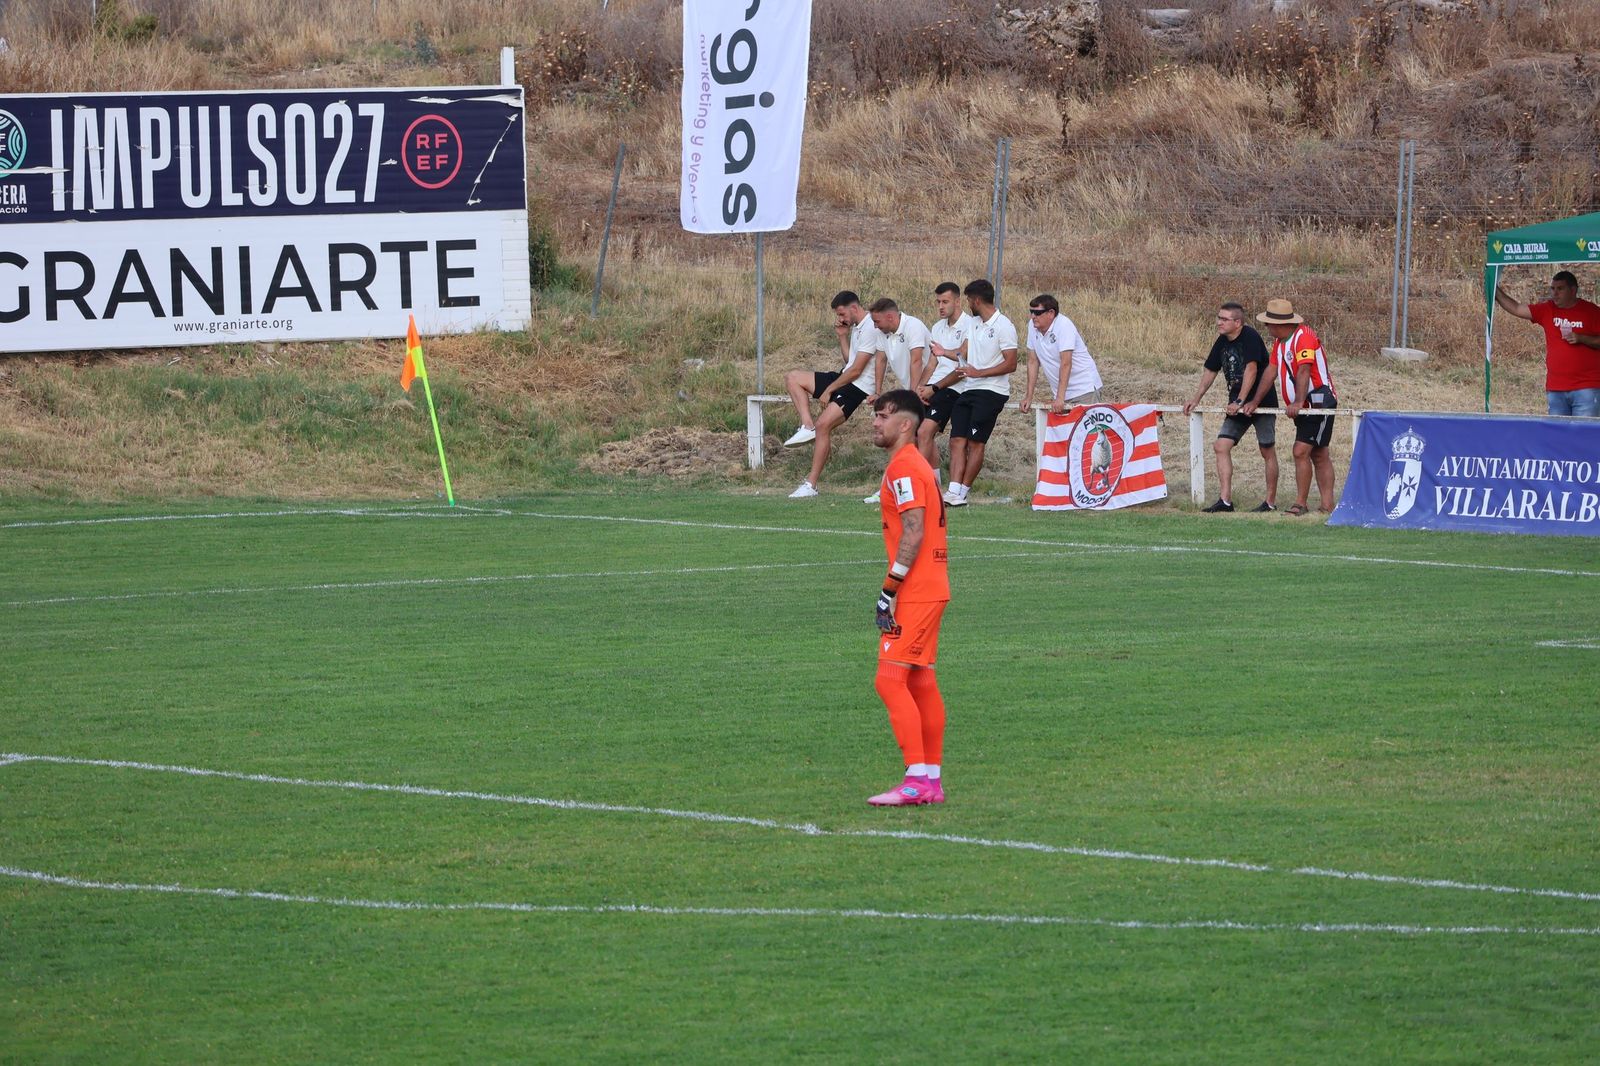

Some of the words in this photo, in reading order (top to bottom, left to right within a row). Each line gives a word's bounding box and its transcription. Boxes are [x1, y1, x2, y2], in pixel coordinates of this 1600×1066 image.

[690, 135, 705, 147] y
[50, 103, 385, 211] IMPULSO27
[1503, 243, 1522, 254] CAJA
[1523, 242, 1549, 253] RURAL
[0, 239, 481, 324] GRANIARTE
[173, 318, 293, 333] www.graniarte.org
[1301, 350, 1308, 358] C
[1435, 456, 1592, 484] AYUNTAMIENTO
[1434, 485, 1600, 523] VILLARALB
